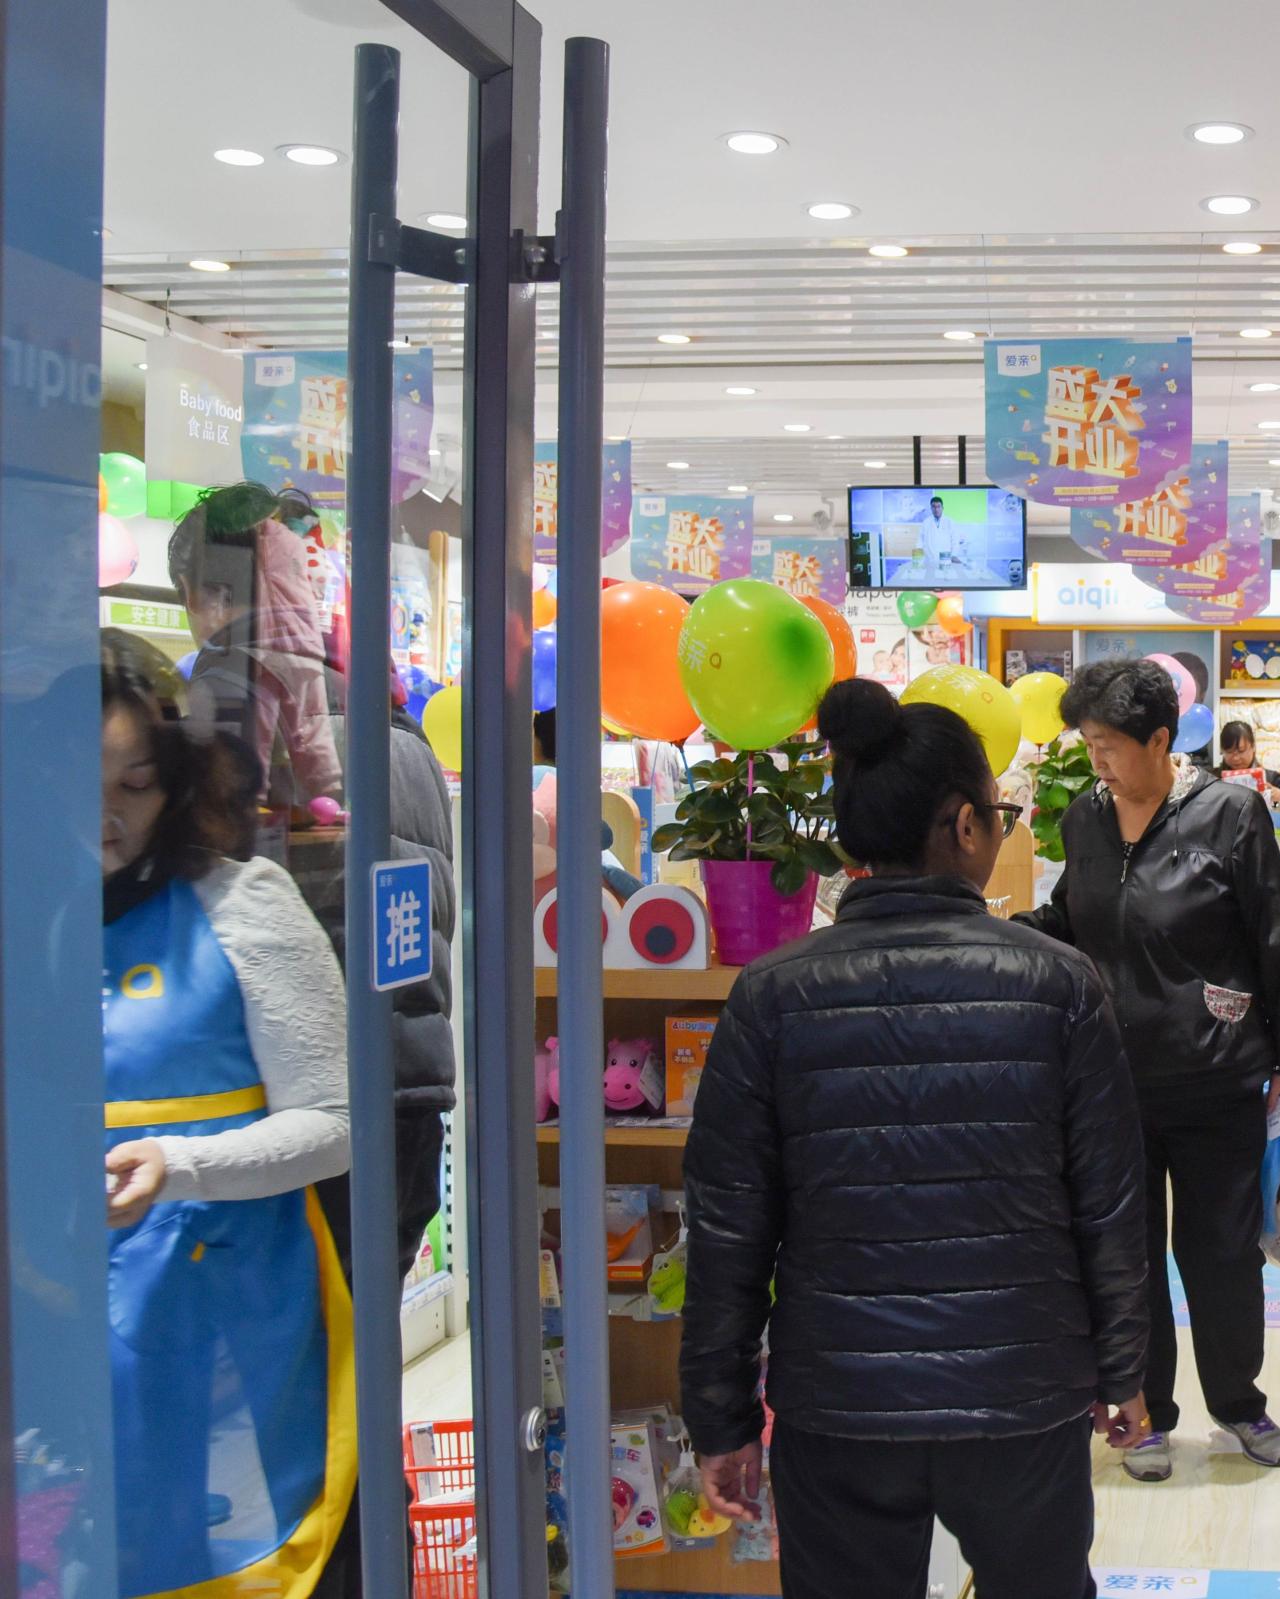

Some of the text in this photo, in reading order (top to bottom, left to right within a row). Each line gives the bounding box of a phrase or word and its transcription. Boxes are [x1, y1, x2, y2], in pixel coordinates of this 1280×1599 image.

[1006, 354, 1030, 367] 爱亲
[179, 388, 242, 421] Baby food
[1046, 366, 1142, 431] 盛大
[188, 416, 230, 445] 食品区
[1041, 416, 1141, 479] 开业
[666, 511, 726, 551] 盛大
[663, 540, 722, 581] 开业
[386, 889, 421, 967] 推
[1103, 1574, 1175, 1591] 爱亲
